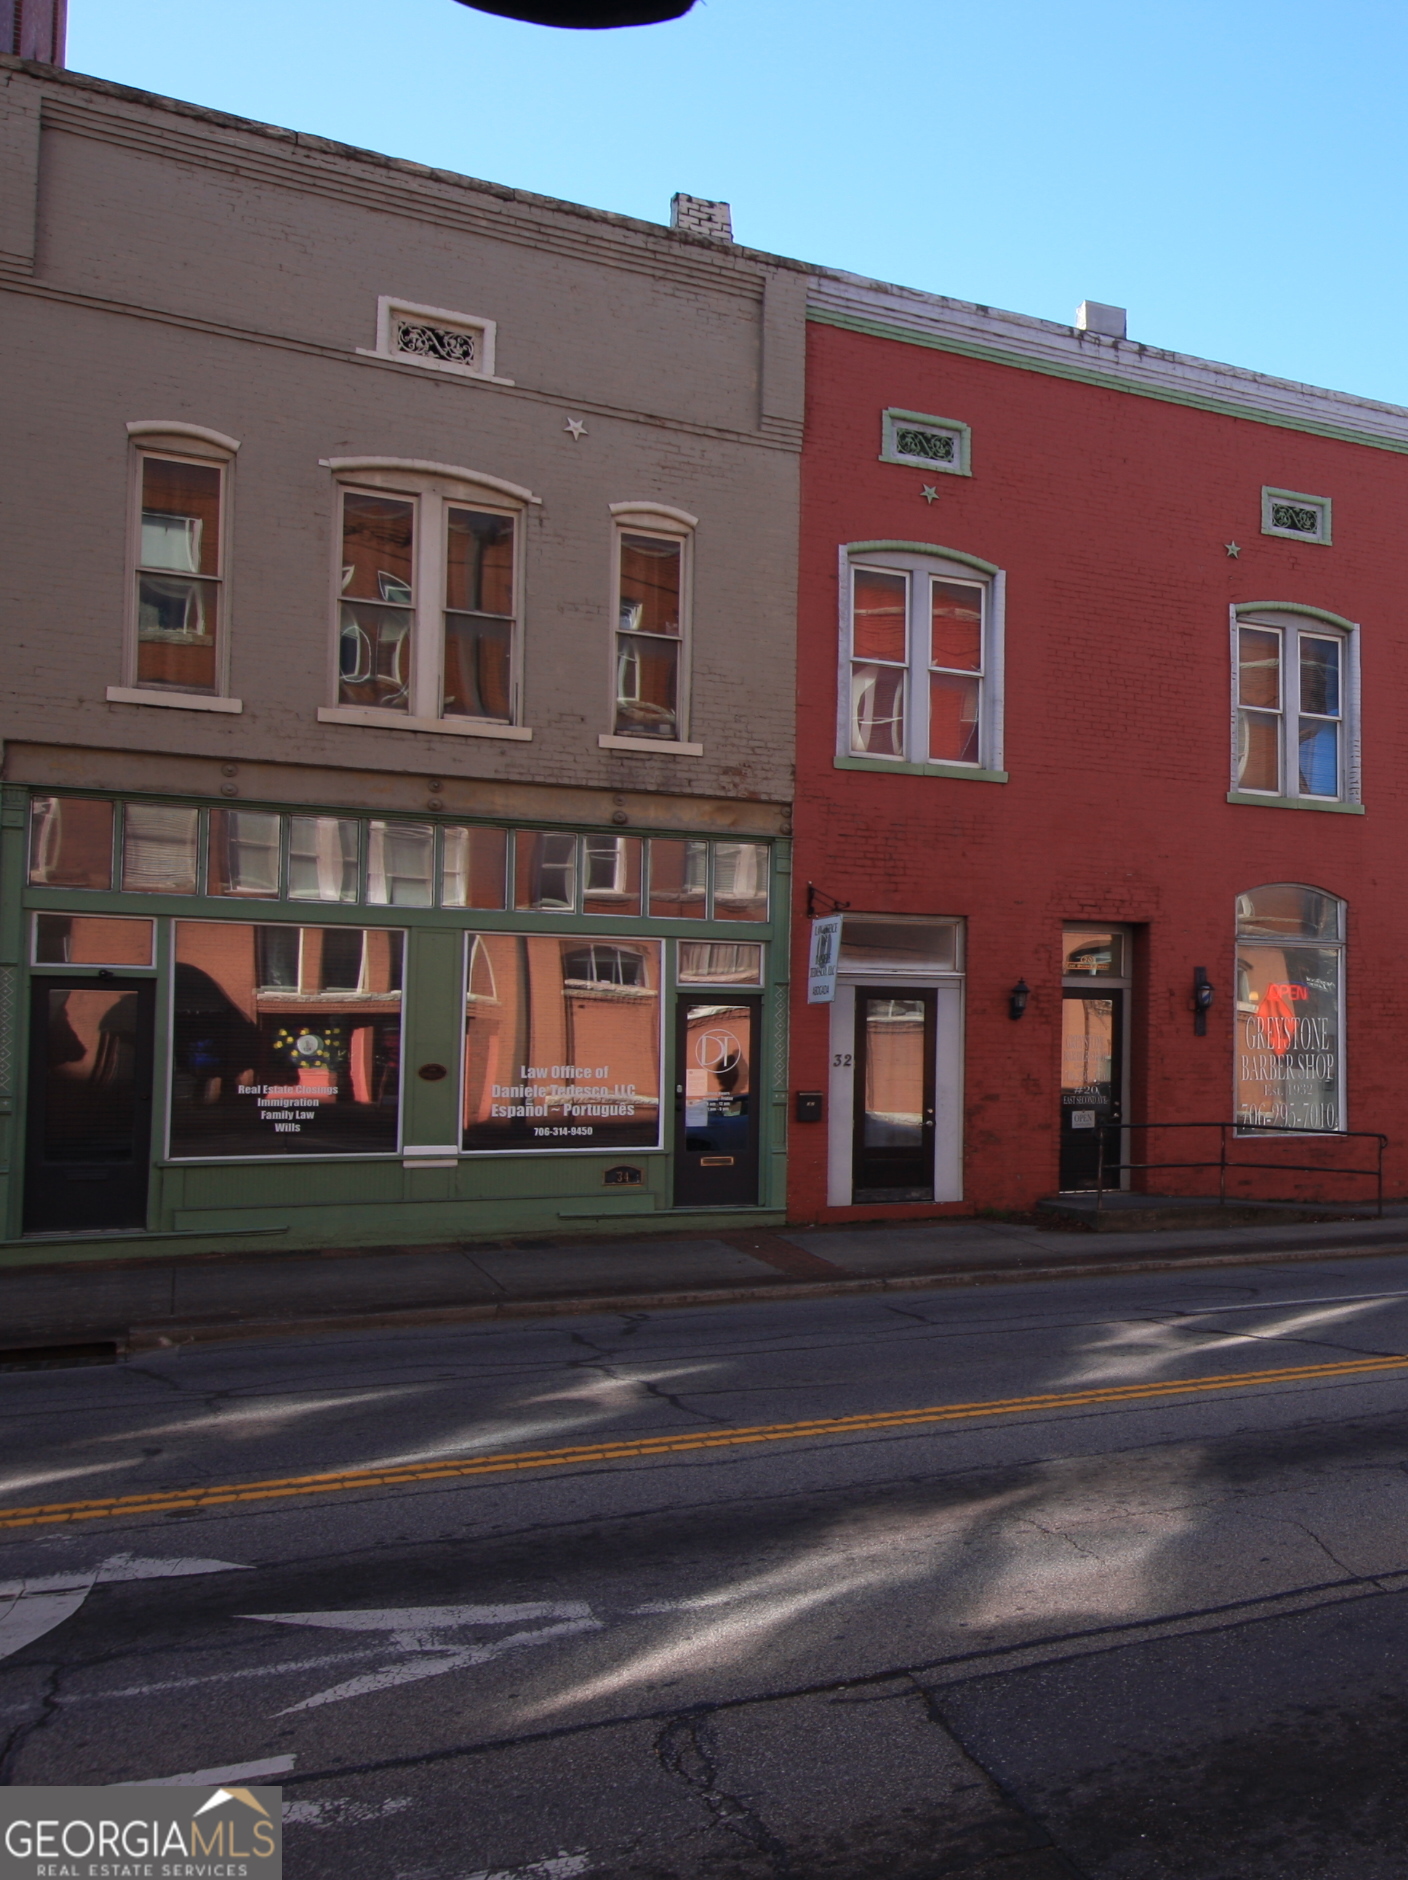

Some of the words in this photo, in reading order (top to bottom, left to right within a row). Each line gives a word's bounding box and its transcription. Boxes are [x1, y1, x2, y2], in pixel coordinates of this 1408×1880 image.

[1271, 984, 1309, 1001] OPEN
[1246, 1016, 1329, 1050] GREYSTONE
[833, 1054, 852, 1067] 32
[1241, 1055, 1294, 1081] BARBER
[1298, 1053, 1334, 1080] SHOP
[520, 1065, 548, 1079] Law
[551, 1065, 592, 1079] Office
[595, 1065, 609, 1079] of
[238, 1084, 261, 1094] Real
[262, 1084, 293, 1094] Estate
[295, 1084, 339, 1095] Closings
[491, 1084, 546, 1098] Daniele
[614, 1084, 636, 1097] LLC
[1264, 1084, 1284, 1096] Est.
[1288, 1083, 1313, 1095] 1932
[257, 1098, 320, 1108] Immigration
[261, 1110, 294, 1120] Family
[295, 1110, 315, 1119] Law
[491, 1102, 548, 1118] Español
[563, 1102, 635, 1117] Português
[1074, 1114, 1092, 1123] OPEN
[274, 1123, 301, 1132] Wills
[534, 1126, 593, 1136] 706-314-9450
